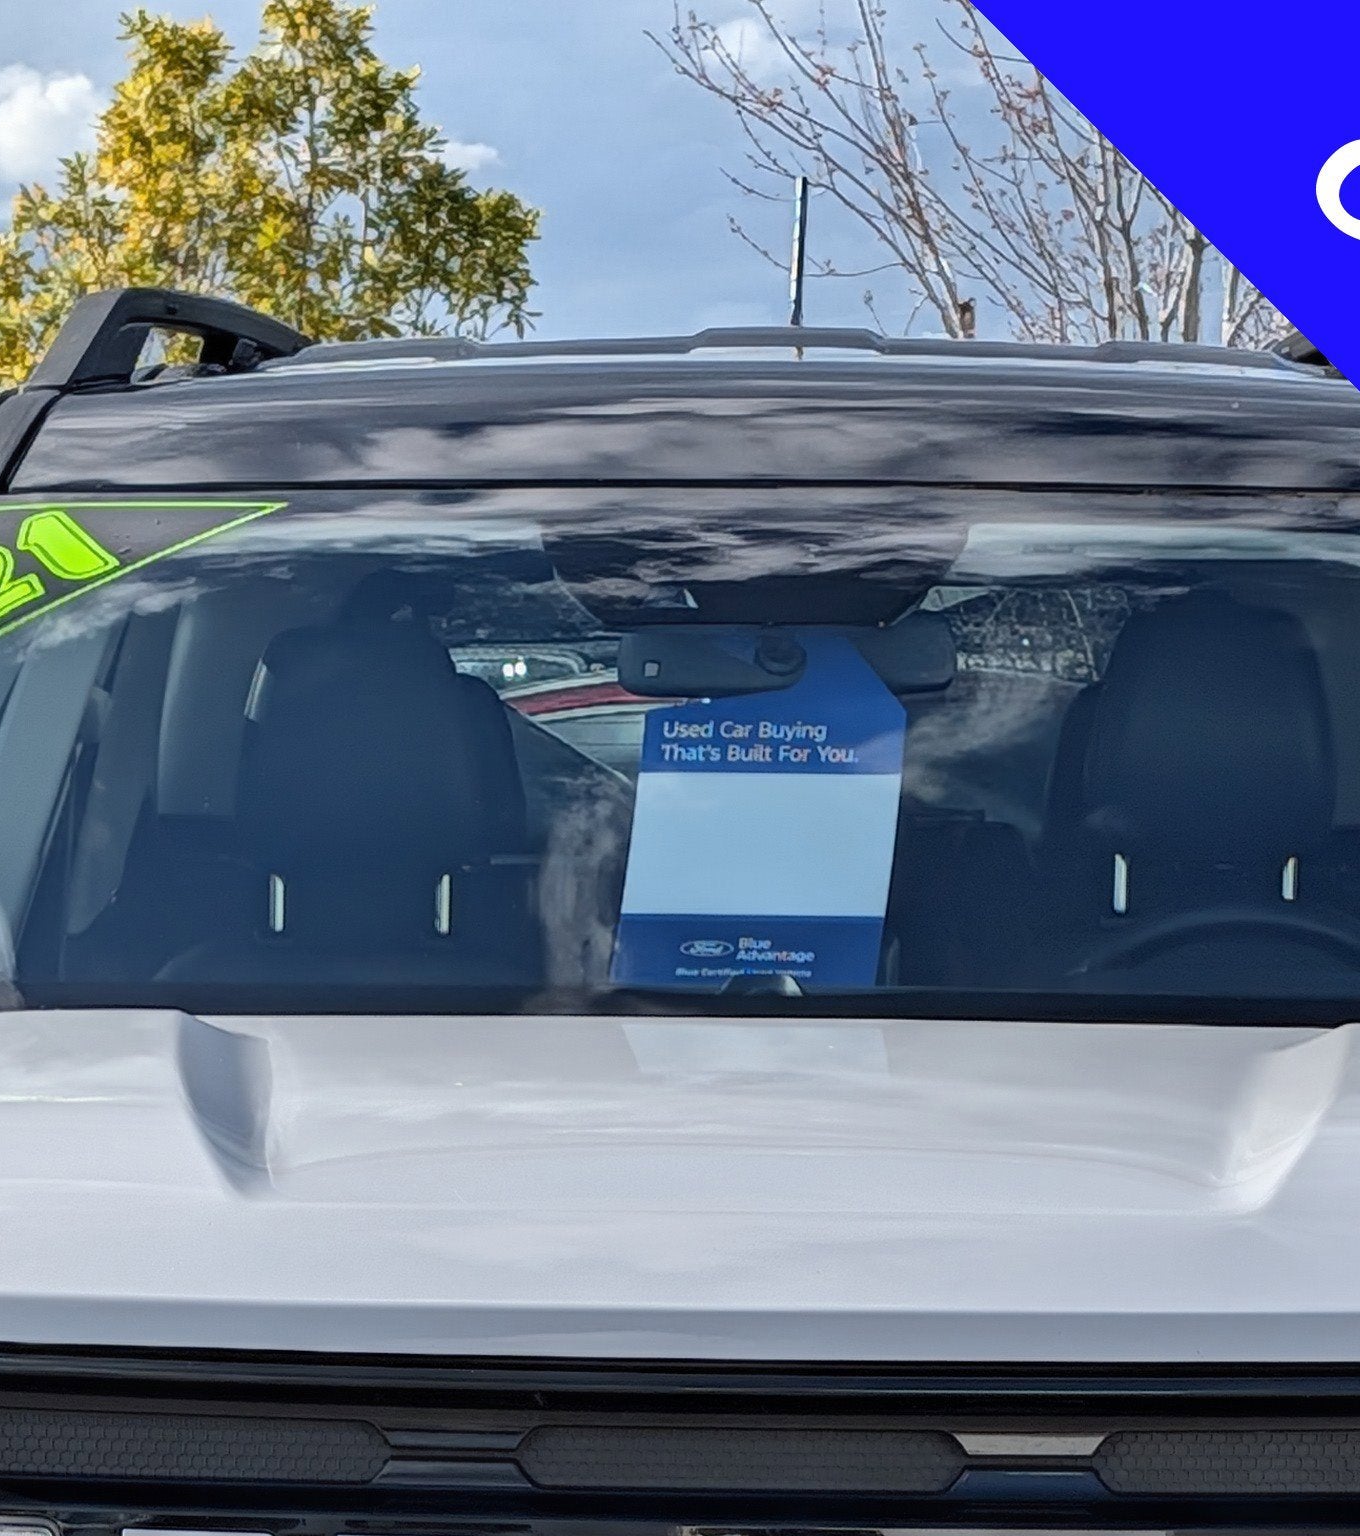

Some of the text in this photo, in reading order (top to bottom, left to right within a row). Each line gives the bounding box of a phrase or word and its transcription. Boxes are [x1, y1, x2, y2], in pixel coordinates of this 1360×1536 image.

[662, 720, 828, 743] Used Car Buying
[661, 743, 860, 764] That's Built For You.
[738, 937, 772, 950] Blue
[735, 950, 816, 963] Advantage
